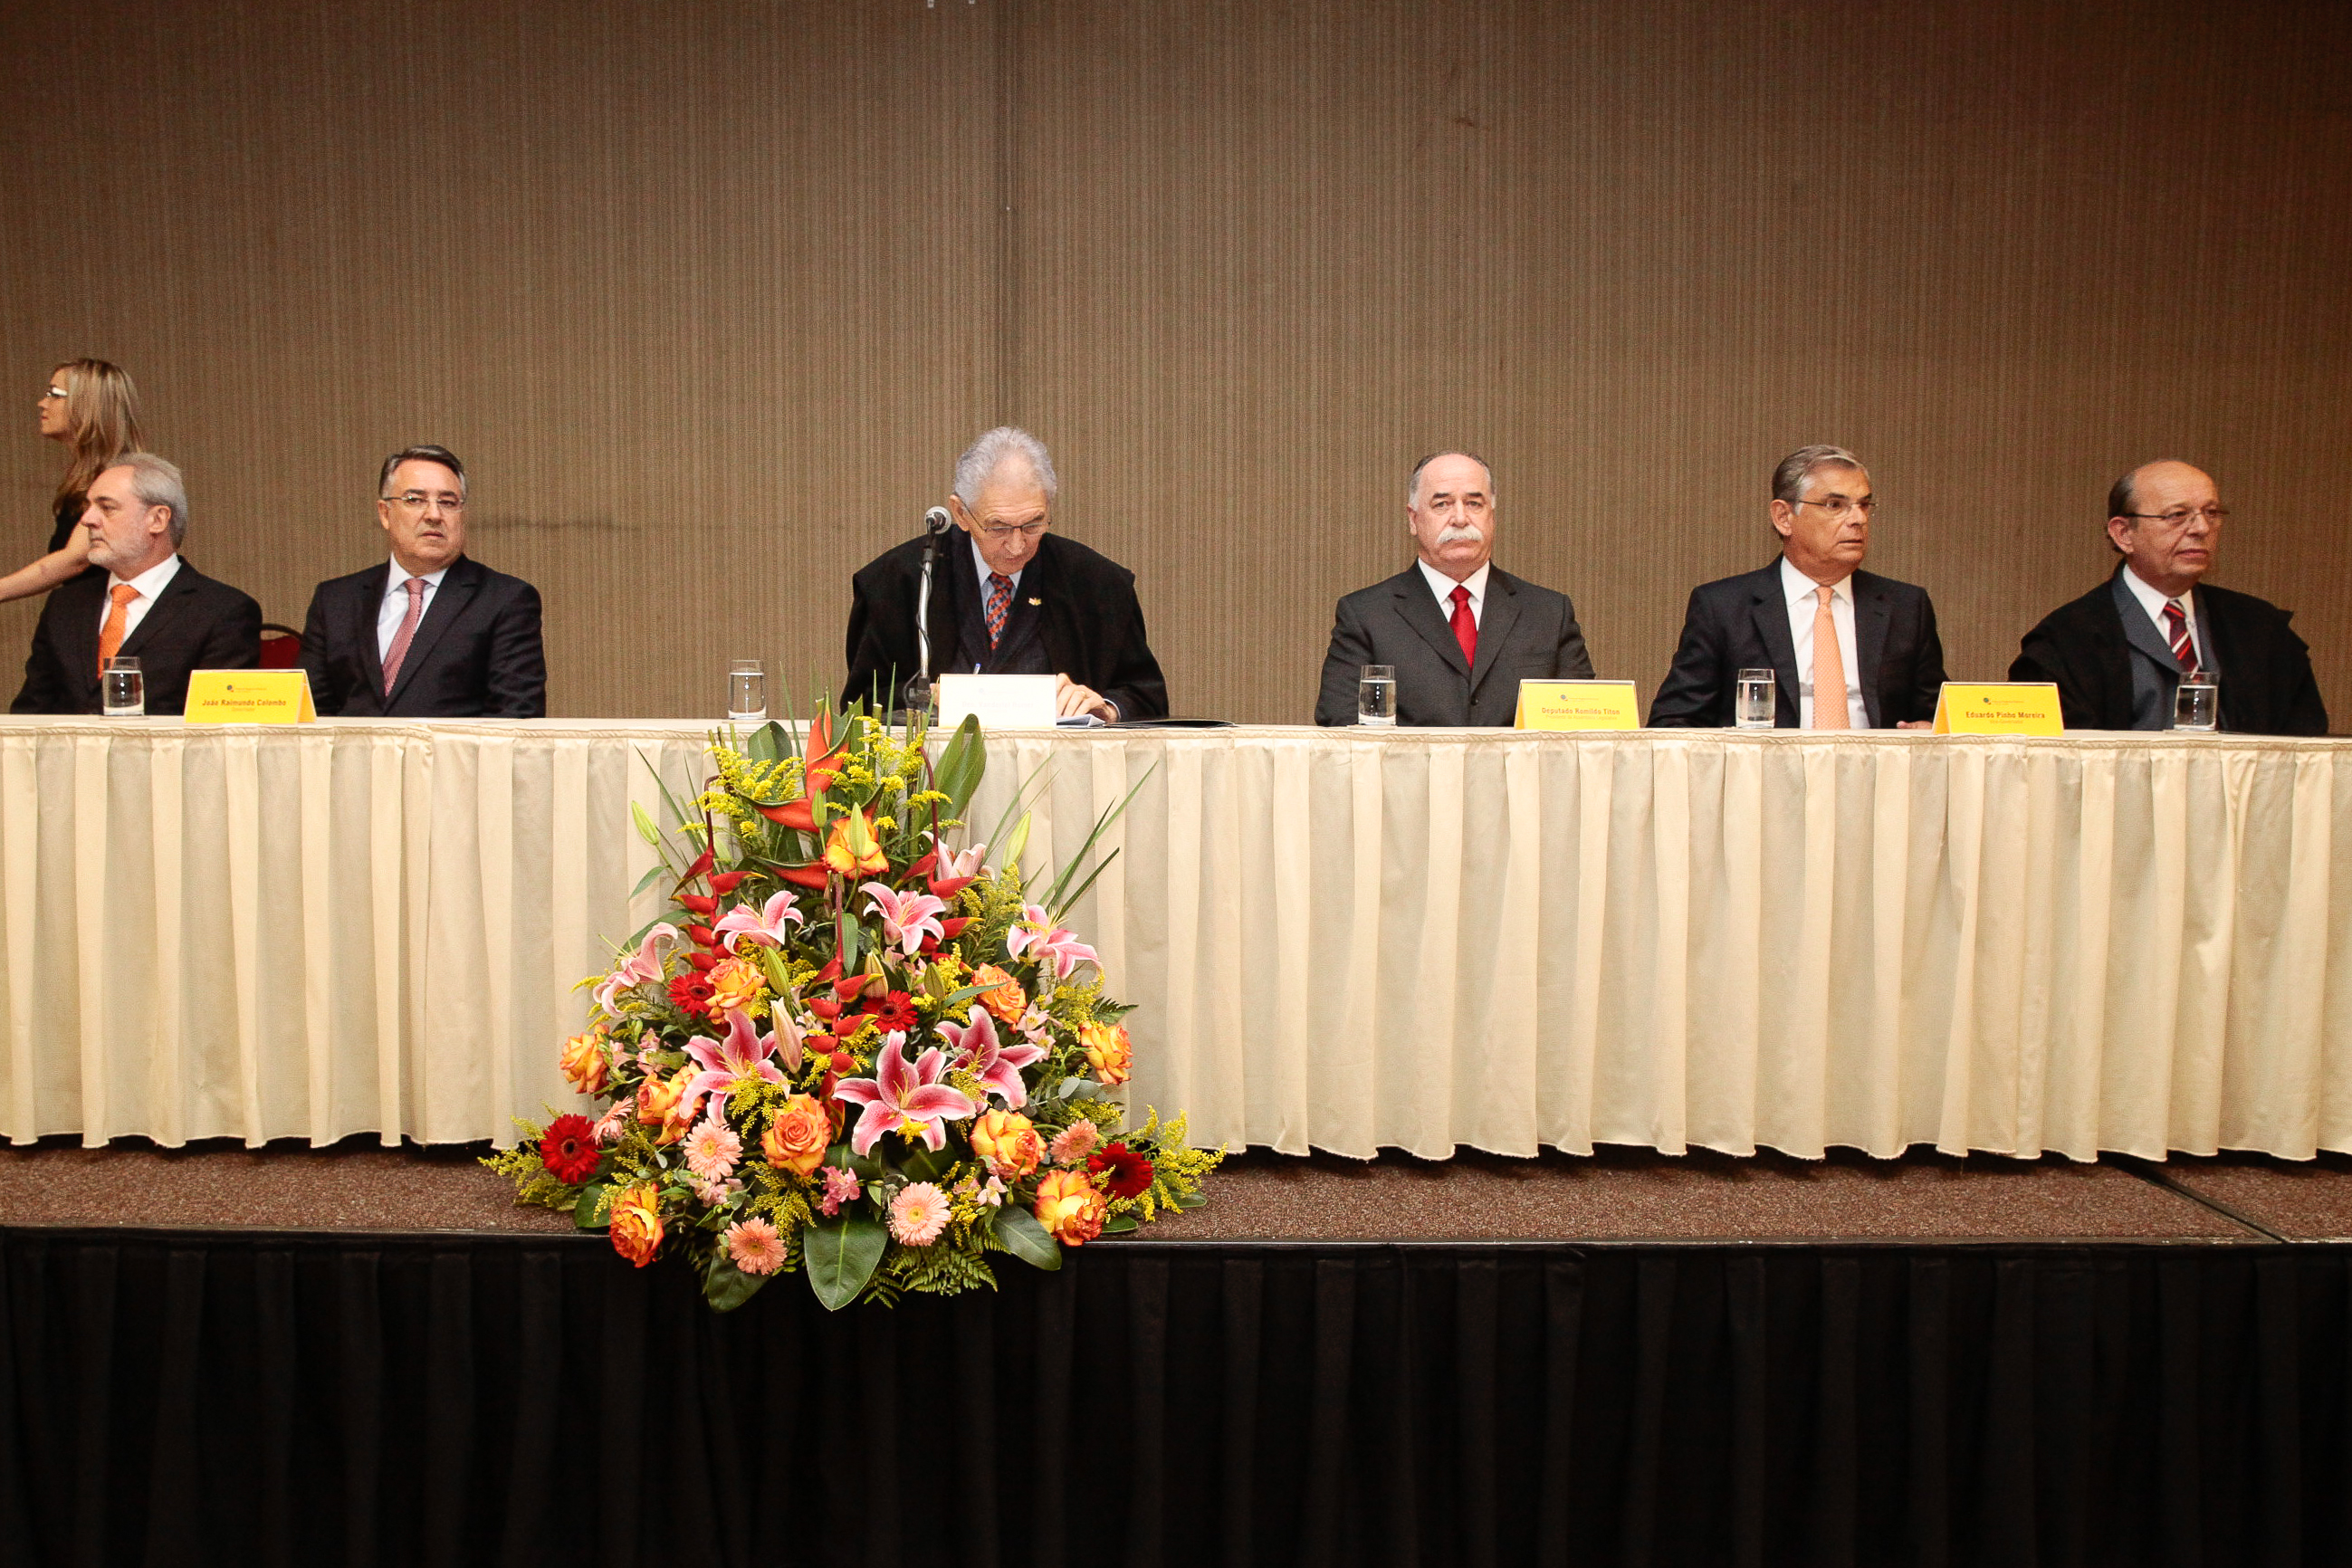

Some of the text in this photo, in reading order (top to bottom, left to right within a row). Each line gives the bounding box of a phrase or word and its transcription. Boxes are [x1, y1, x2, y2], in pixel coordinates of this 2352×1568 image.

[1542, 707, 1573, 715] Deputado
[1575, 707, 1601, 715] Romildo
[1965, 711, 1994, 719] Eduardo
